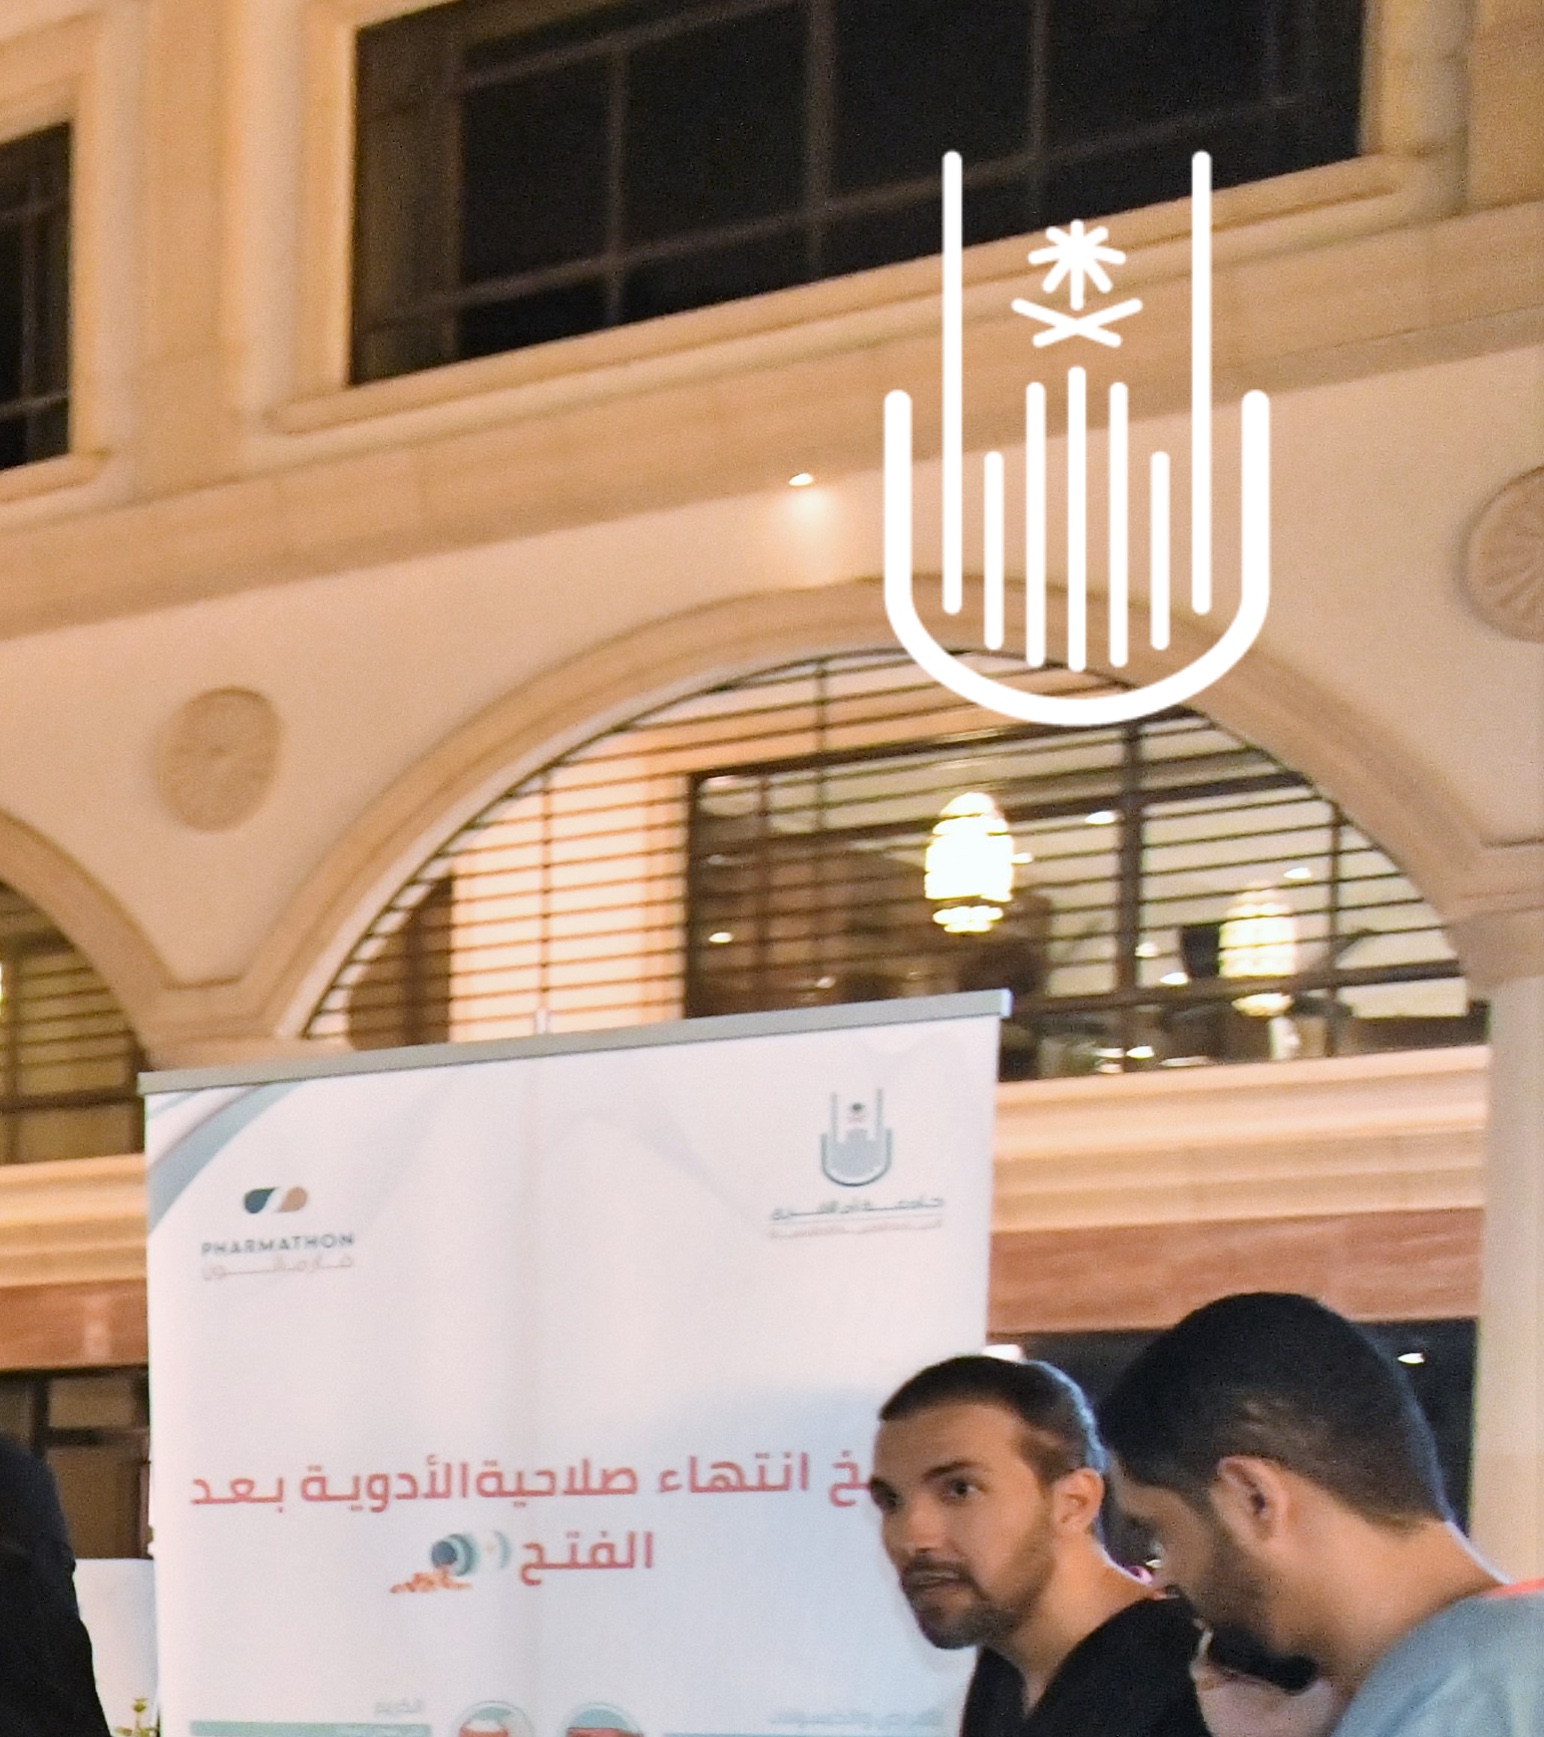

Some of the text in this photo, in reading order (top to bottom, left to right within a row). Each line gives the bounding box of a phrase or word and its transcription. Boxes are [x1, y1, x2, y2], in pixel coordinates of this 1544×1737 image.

[201, 1232, 355, 1255] PHARMATHON
[190, 1473, 284, 1513] بعد
[300, 1455, 467, 1513] الأدوية
[475, 1458, 640, 1508] صلاحية
[657, 1450, 811, 1496] انتهاء
[520, 1530, 656, 1587] الفتح
